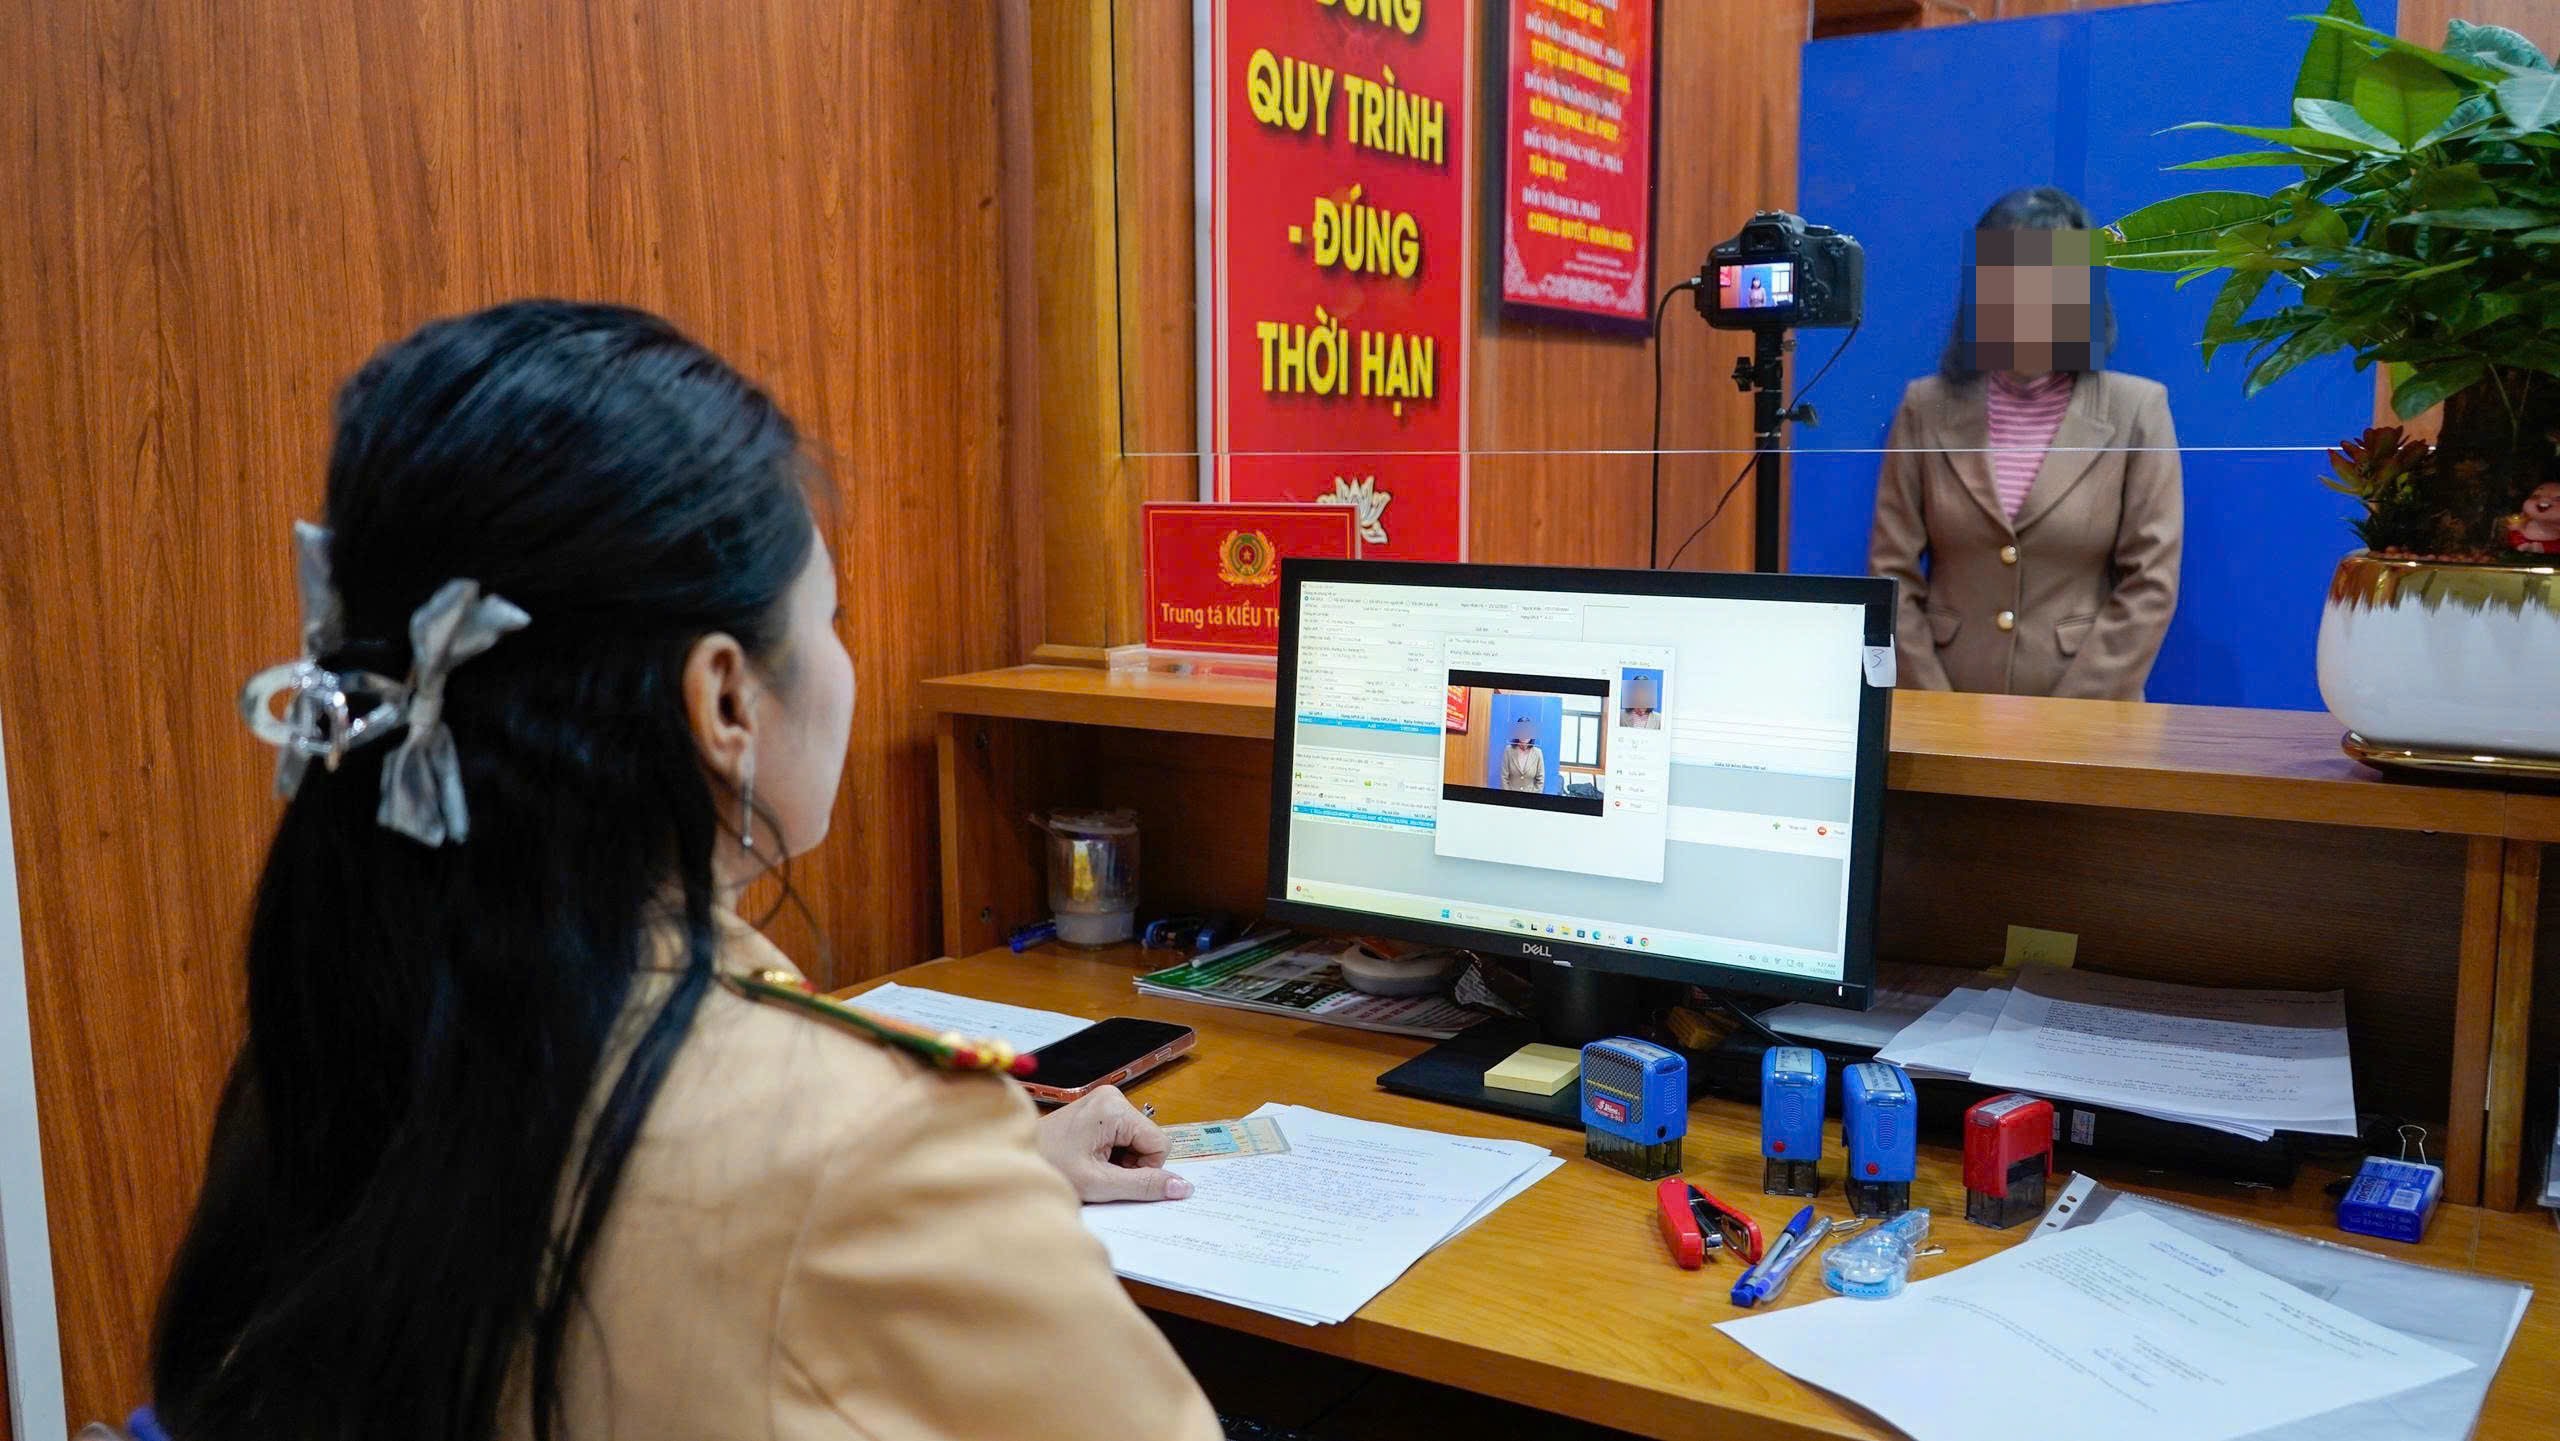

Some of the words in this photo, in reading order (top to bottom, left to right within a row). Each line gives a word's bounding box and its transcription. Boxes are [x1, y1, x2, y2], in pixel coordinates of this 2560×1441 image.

[1247, 48, 1334, 136] QUY
[1343, 64, 1443, 164] TRÌNH
[1312, 183, 1420, 279] ĐÚNG
[1256, 304, 1349, 395] THỜI
[1360, 330, 1434, 417] HẠN
[1161, 603, 1204, 630] Trung
[1207, 606, 1223, 625] tá
[1871, 648, 1885, 669] 3
[1522, 942, 1552, 958] DELL
